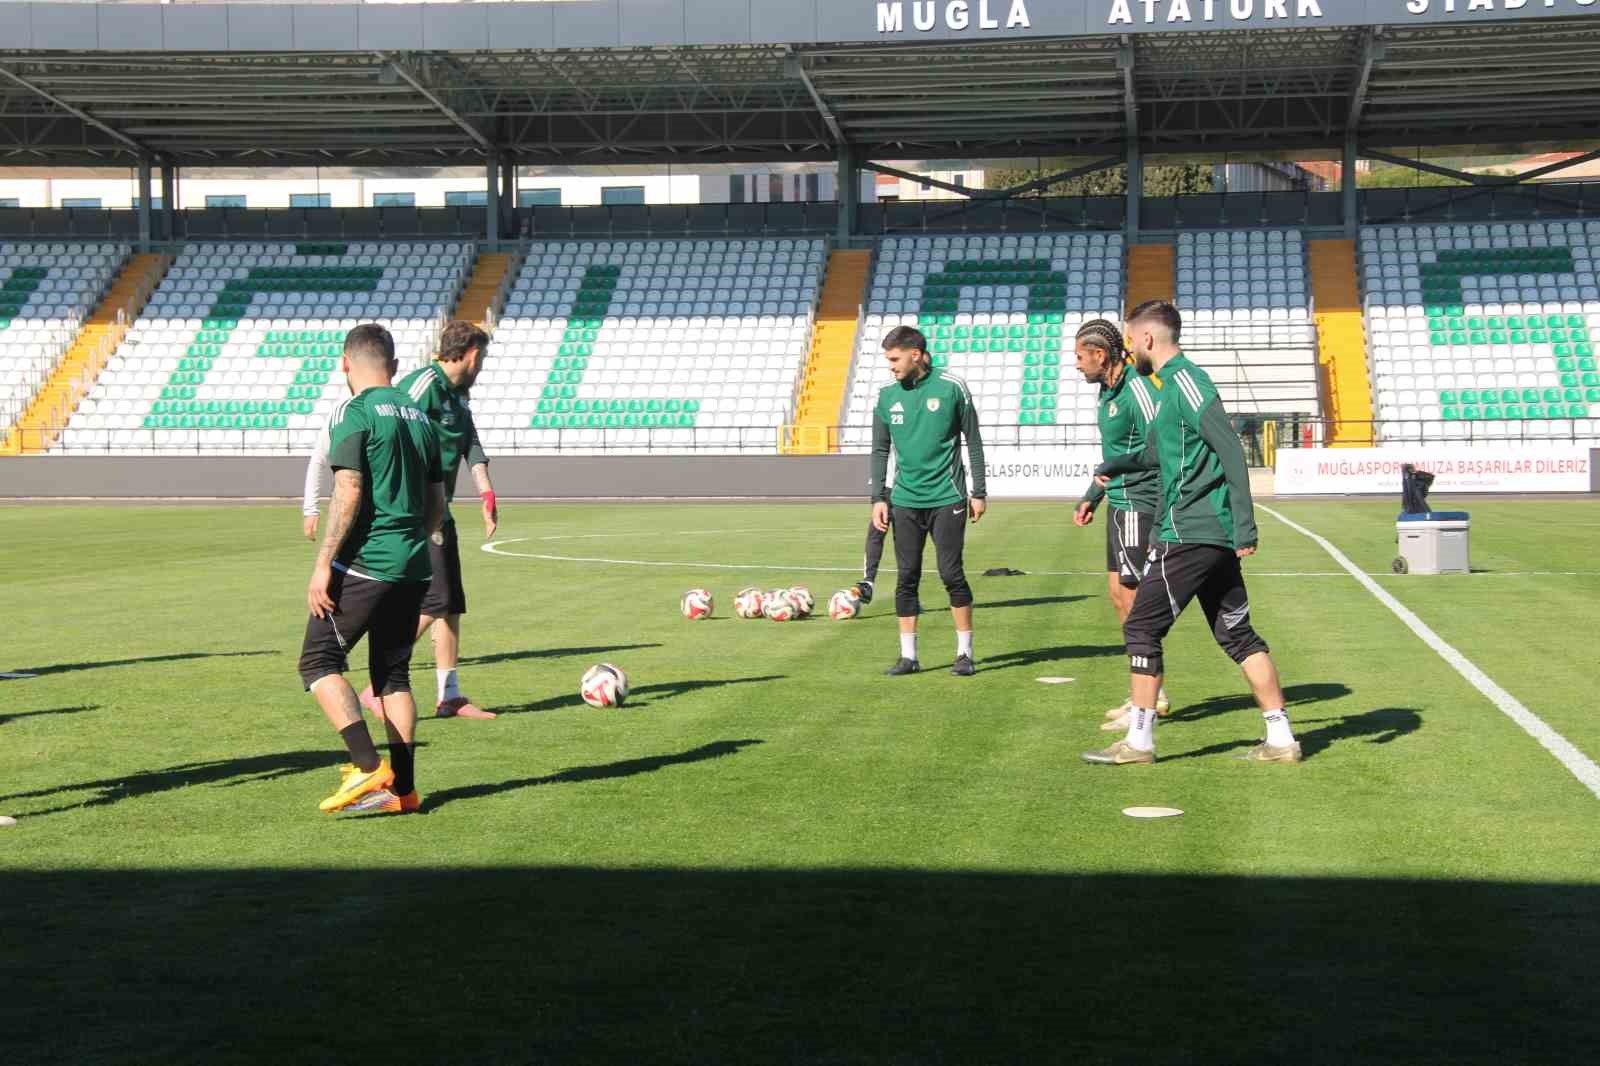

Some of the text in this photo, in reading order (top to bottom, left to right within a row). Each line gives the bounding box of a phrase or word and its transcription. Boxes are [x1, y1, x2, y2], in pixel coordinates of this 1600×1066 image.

[890, 414, 904, 425] 28
[1457, 460, 1532, 478] BAŞARILAR
[1536, 457, 1588, 474] DİLERİZ
